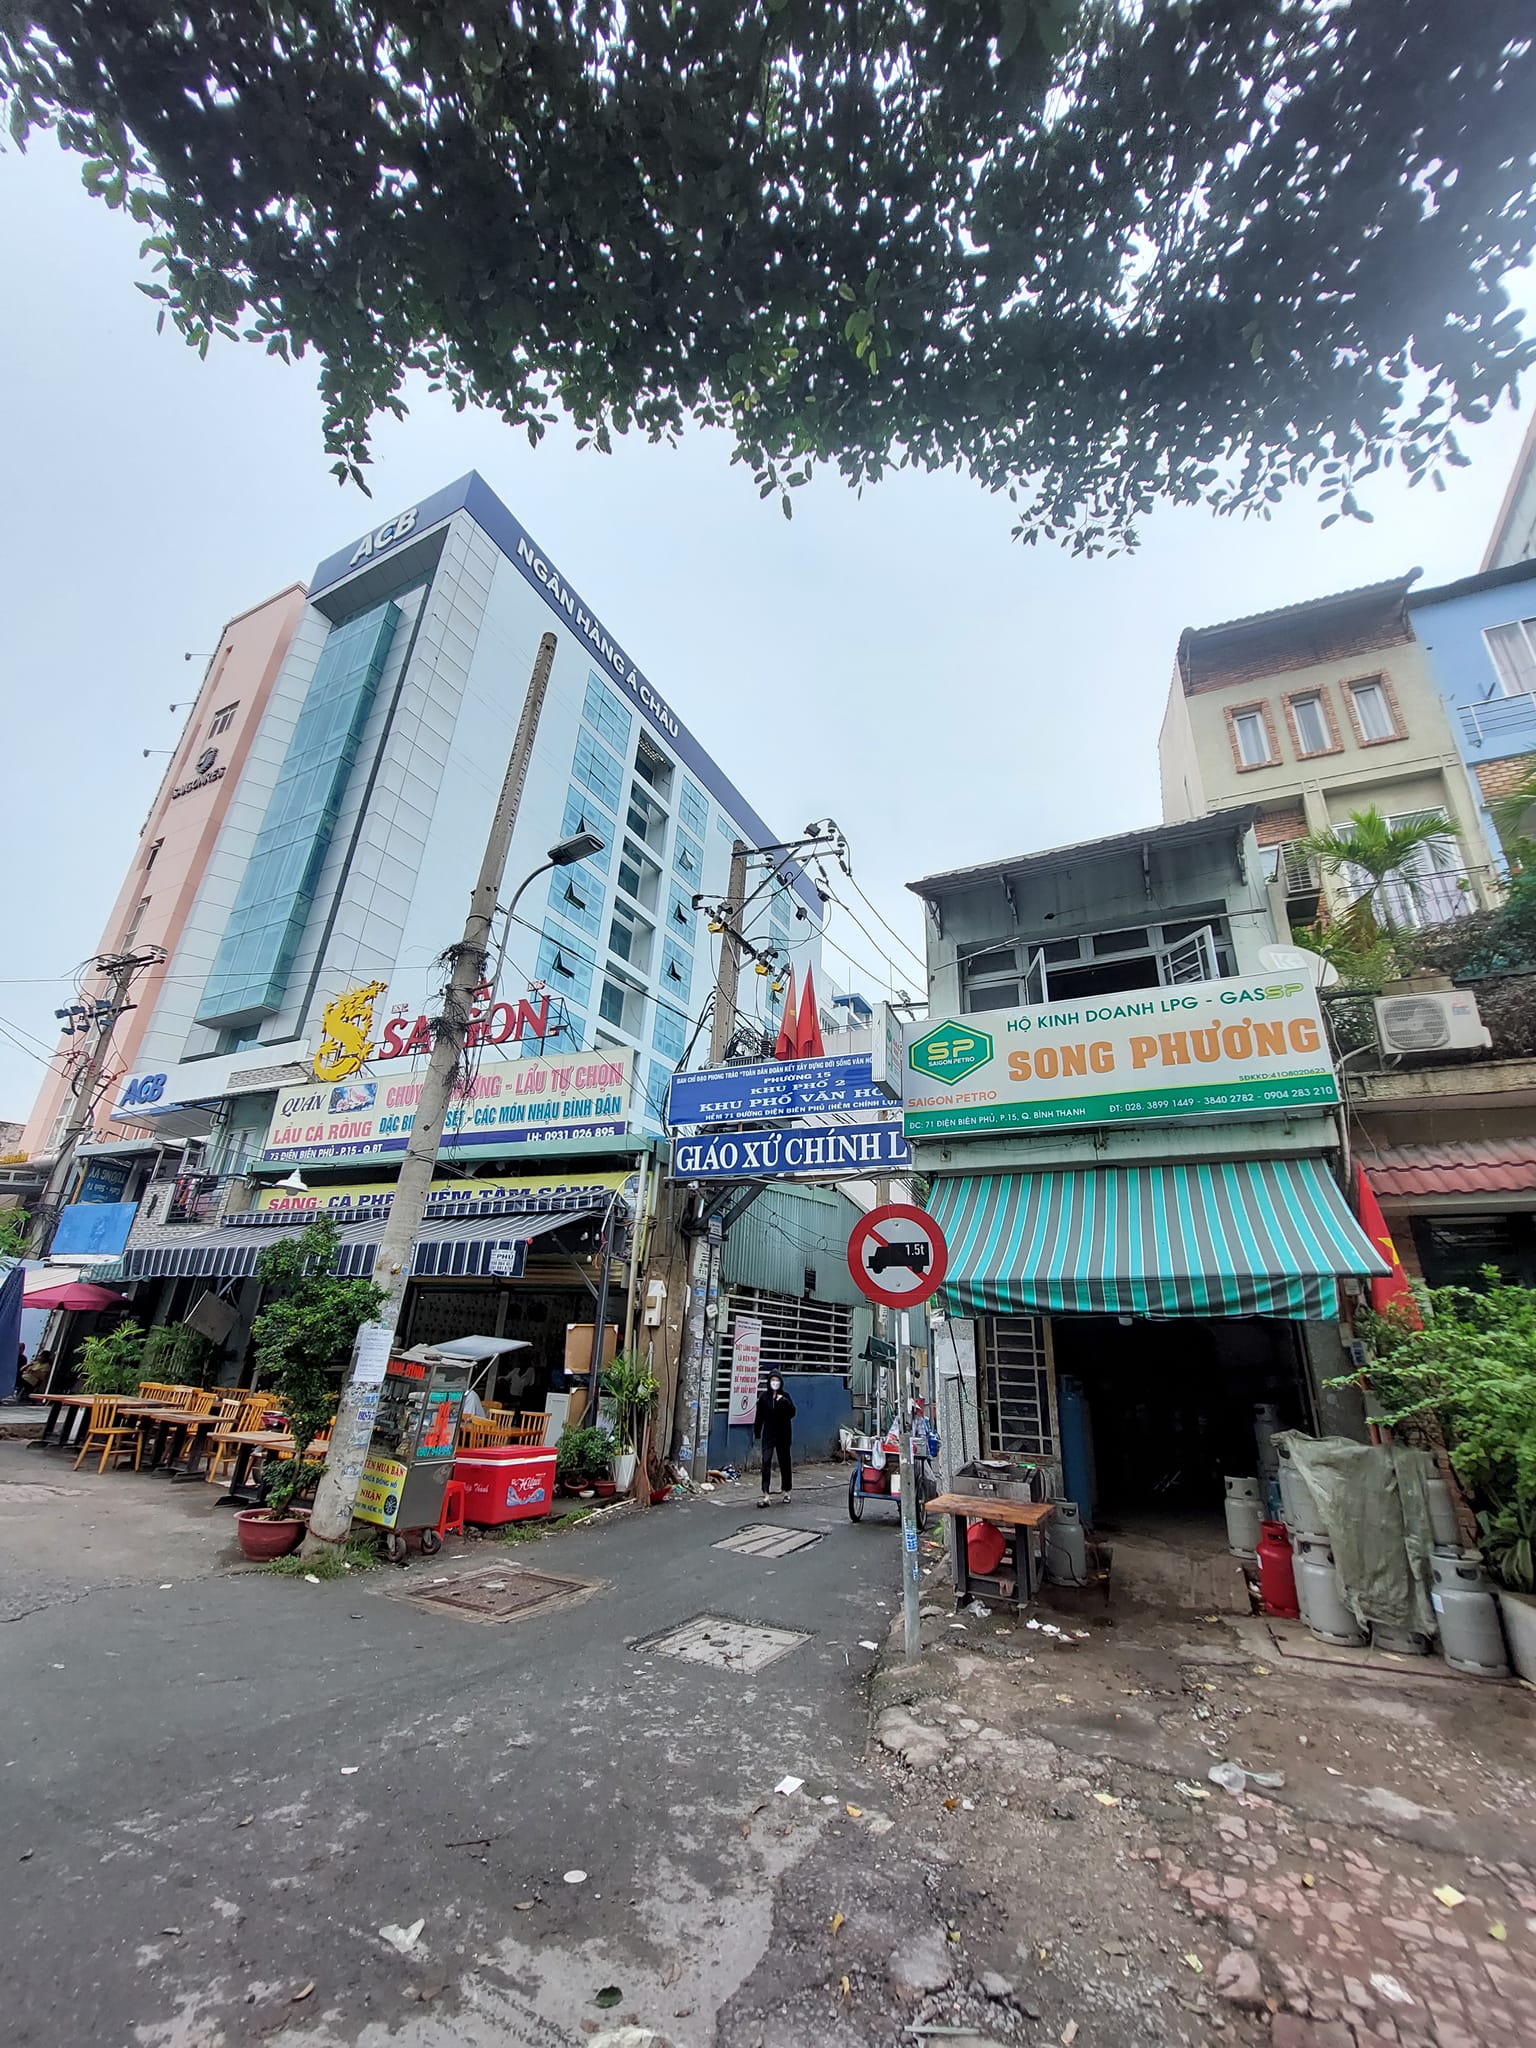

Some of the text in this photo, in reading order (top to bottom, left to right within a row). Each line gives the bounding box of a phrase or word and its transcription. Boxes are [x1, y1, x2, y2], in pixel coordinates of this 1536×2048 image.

[348, 508, 418, 567] ACB
[517, 538, 679, 738] NGÂN HÀNG Á CHÂU
[1007, 1015, 1032, 1033] HỘ
[1037, 1012, 1080, 1029] KINH
[1086, 1002, 1155, 1022] DOANH
[1161, 996, 1199, 1013] LPG
[927, 1038, 976, 1061] SP
[1008, 1017, 1322, 1082] SONG PHƯƠNG
[708, 1073, 725, 1081] PHONG
[852, 1057, 865, 1065] VĂN
[928, 1056, 976, 1068] SAIGON PETRO
[119, 1073, 167, 1106] ACB
[515, 1063, 547, 1095] LẨU
[550, 1066, 575, 1097] TỰ
[575, 1062, 625, 1093] CHỌN
[750, 1085, 787, 1095] KHU
[792, 1078, 829, 1091] PHỐ
[763, 1073, 812, 1084] PHƯỜNG
[281, 1092, 326, 1117] QUÁN
[700, 1100, 743, 1112] KHU
[749, 1092, 793, 1108] PHỐ
[800, 1090, 846, 1103] VĂN
[765, 1107, 784, 1116] ĐIỆN
[786, 1105, 806, 1113] BIÊN
[853, 1099, 880, 1108] CHÍNH
[908, 1090, 998, 1108] SAIGON PETRO
[1109, 1104, 1123, 1113] ĐT:
[1125, 1102, 1145, 1112] 028.
[1147, 1099, 1169, 1110] 3899
[1172, 1098, 1194, 1108] 1449
[1204, 1095, 1228, 1105] 3840
[1230, 1093, 1254, 1103] 2782
[1264, 1090, 1288, 1100] 0904
[1291, 1088, 1311, 1098] 283
[1313, 1086, 1333, 1095] 210
[379, 1113, 400, 1136] ĐẶC
[474, 1104, 497, 1125] CÁC
[499, 1102, 526, 1125] MÓN
[528, 1099, 560, 1126] NHẬU
[562, 1097, 592, 1118] BÌNH
[595, 1094, 623, 1116] DÂN
[909, 1121, 924, 1130] ĐC:
[925, 1120, 934, 1128] 71
[936, 1117, 956, 1129] ĐIỆN
[958, 1115, 977, 1126] BIÊN
[1021, 1112, 1031, 1120] Q.
[1034, 1109, 1054, 1119] BÌNH
[1056, 1107, 1086, 1118] THẠNH
[272, 1117, 373, 1145] LẨU CÁ RỒNG
[527, 1126, 615, 1141] LH: 0931 026 895
[300, 1146, 316, 1159] BIÊN
[340, 1145, 356, 1157] P.15
[363, 1143, 383, 1155] Q.BT
[677, 1136, 739, 1172] GIÁO
[742, 1133, 782, 1168] XỨ
[785, 1128, 882, 1166] CHÍNH
[427, 1184, 472, 1201] IỂM
[905, 1243, 925, 1256] 1.5t
